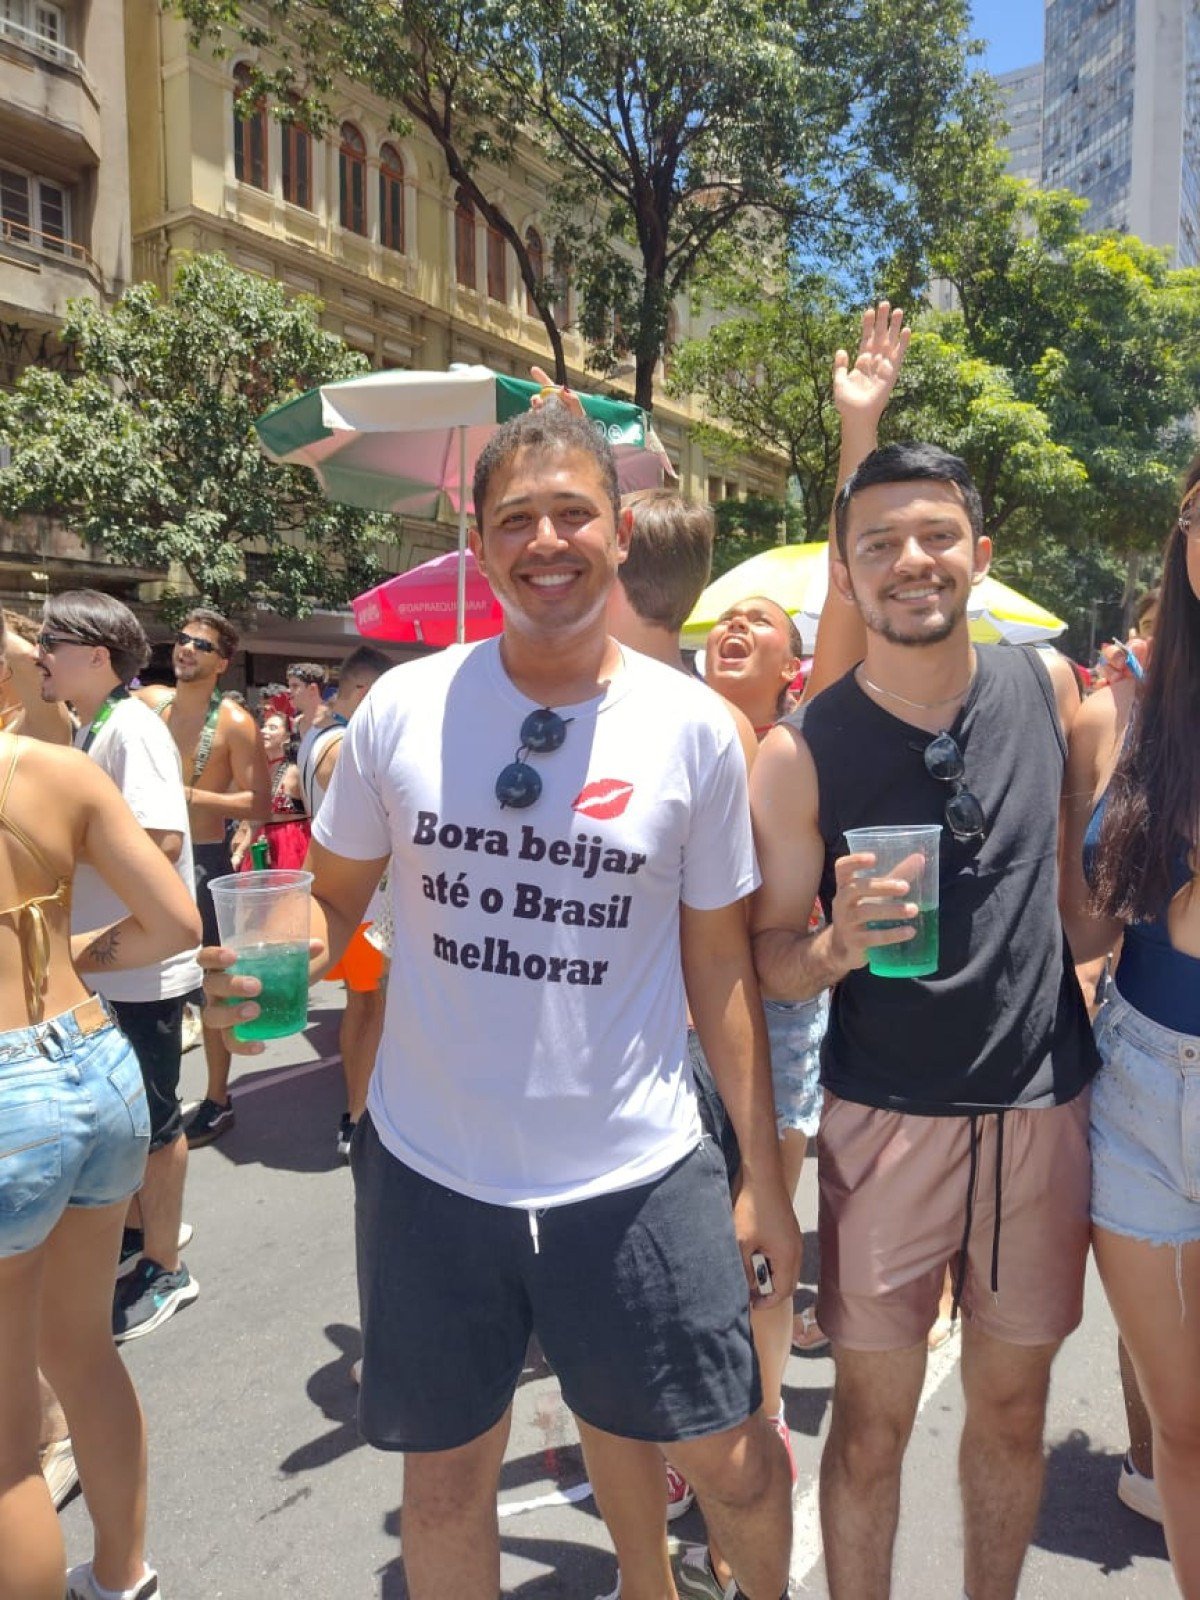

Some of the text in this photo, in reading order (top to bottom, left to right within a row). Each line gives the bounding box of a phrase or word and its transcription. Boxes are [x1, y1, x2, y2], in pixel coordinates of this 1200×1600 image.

[413, 811, 647, 878] Bora beijar
[421, 872, 632, 928] até o Brasil
[433, 933, 609, 985] melhorar
